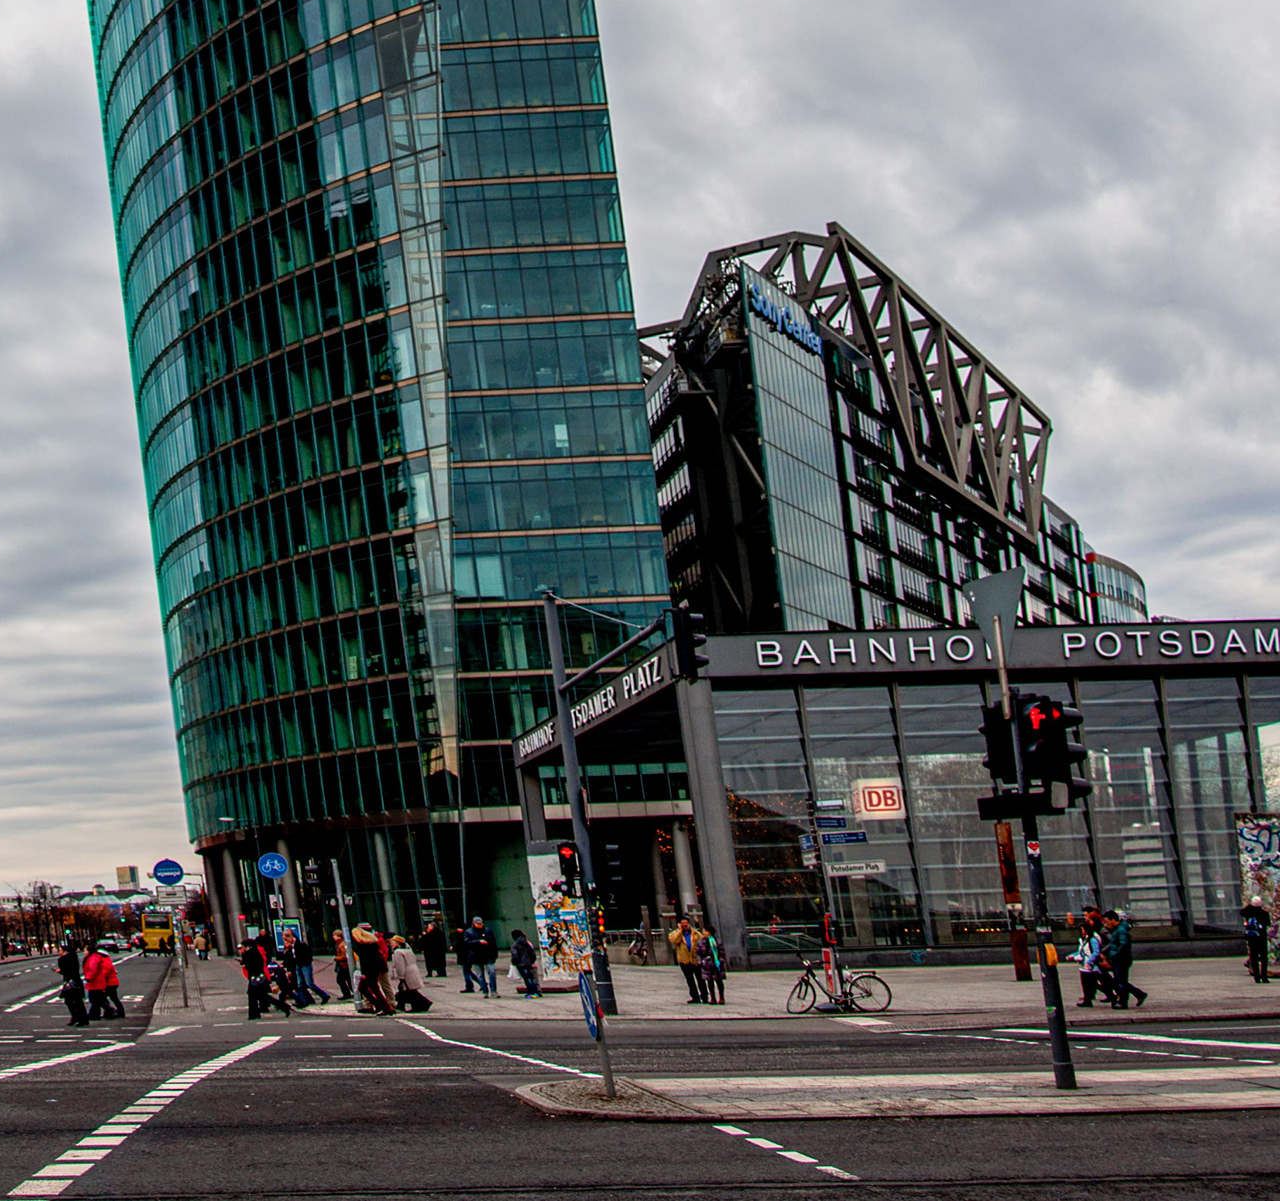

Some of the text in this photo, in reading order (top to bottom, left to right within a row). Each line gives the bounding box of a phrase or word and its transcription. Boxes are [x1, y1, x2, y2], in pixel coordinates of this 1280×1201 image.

[751, 282, 823, 355] Sony Center
[570, 685, 616, 729] TSDAMER
[622, 656, 662, 700] PLATZ
[866, 789, 897, 808] DB
